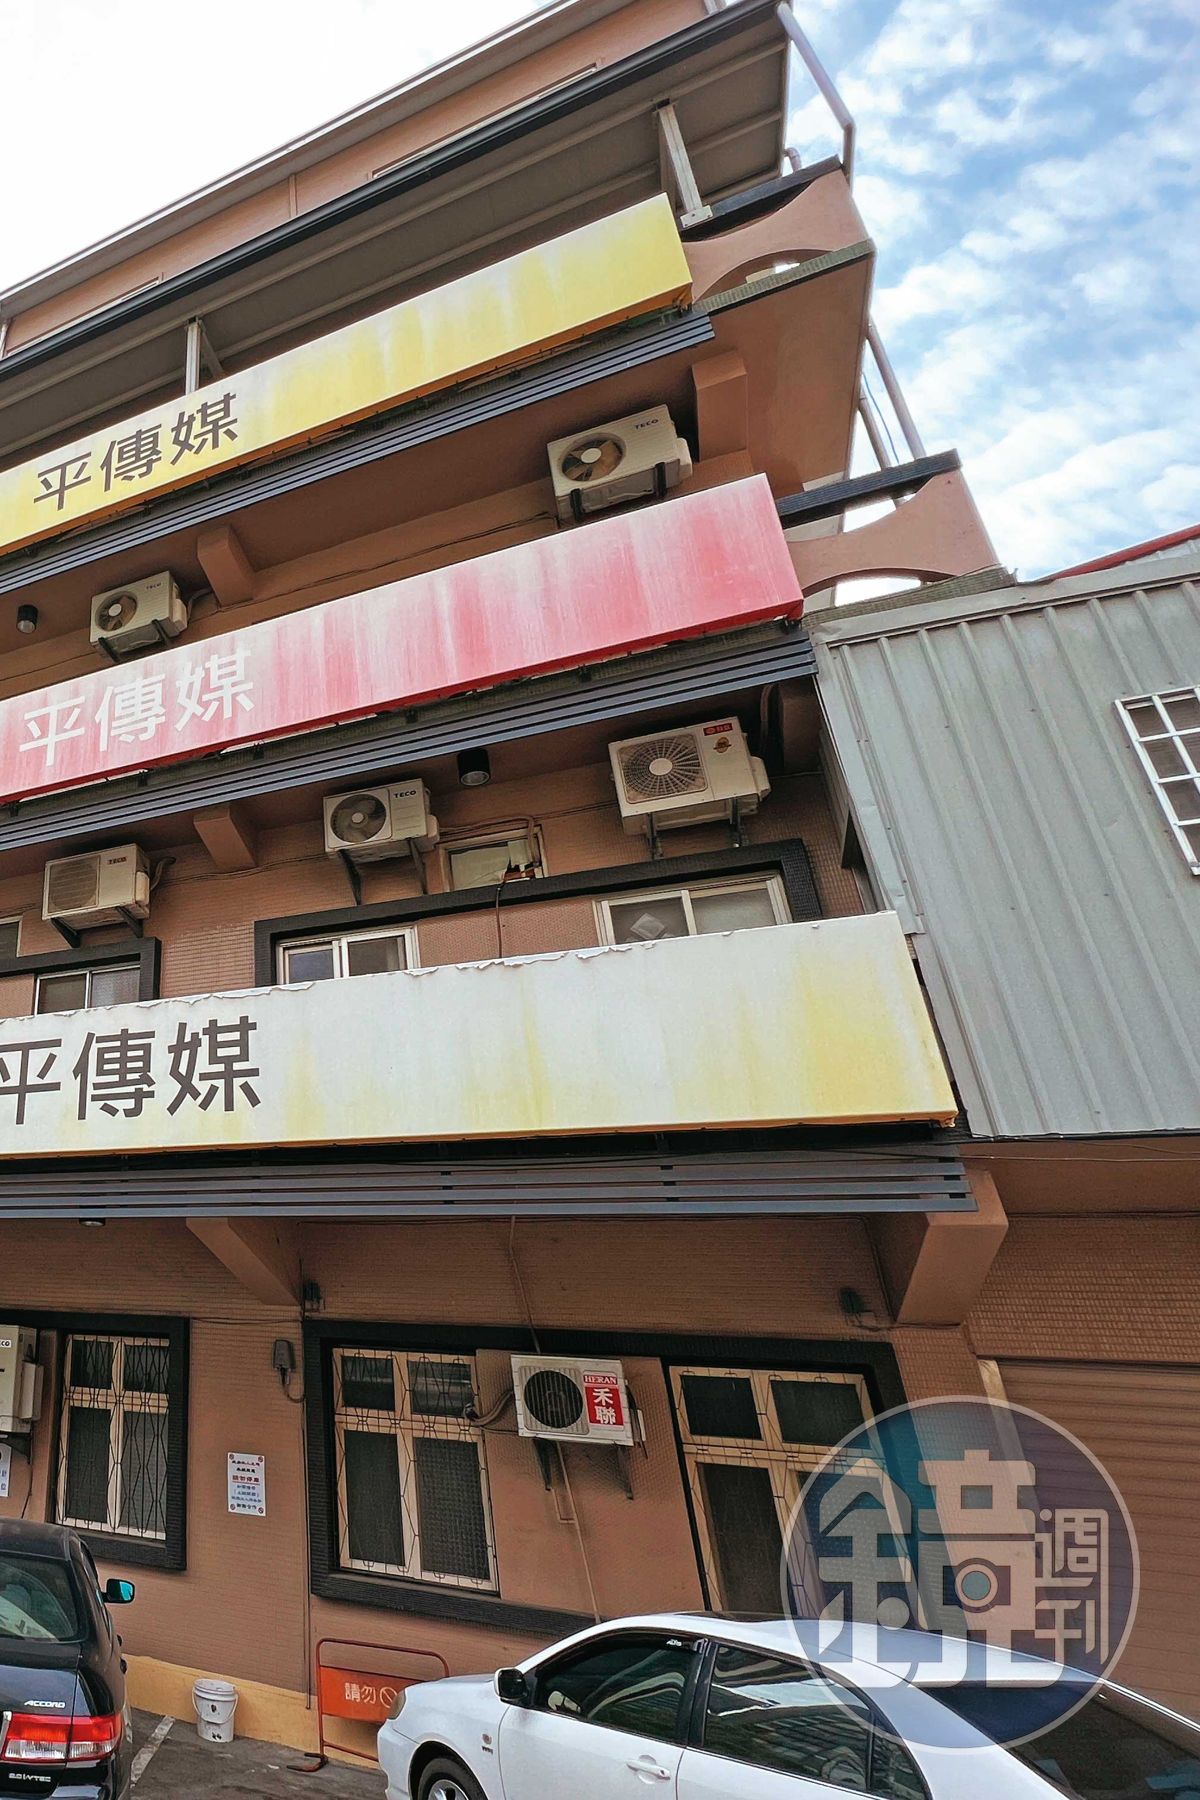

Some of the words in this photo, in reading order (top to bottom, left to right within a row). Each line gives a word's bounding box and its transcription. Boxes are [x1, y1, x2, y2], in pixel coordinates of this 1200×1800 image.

[635, 419, 659, 429] TECO
[33, 392, 238, 510] 平傳媒
[19, 648, 255, 766] 平傳媒
[393, 790, 416, 798] TECO
[584, 1375, 617, 1385] HERAN
[592, 1388, 616, 1425] 禾聯
[344, 1682, 378, 1704] 請勿
[24, 1700, 66, 1708] ACCORD
